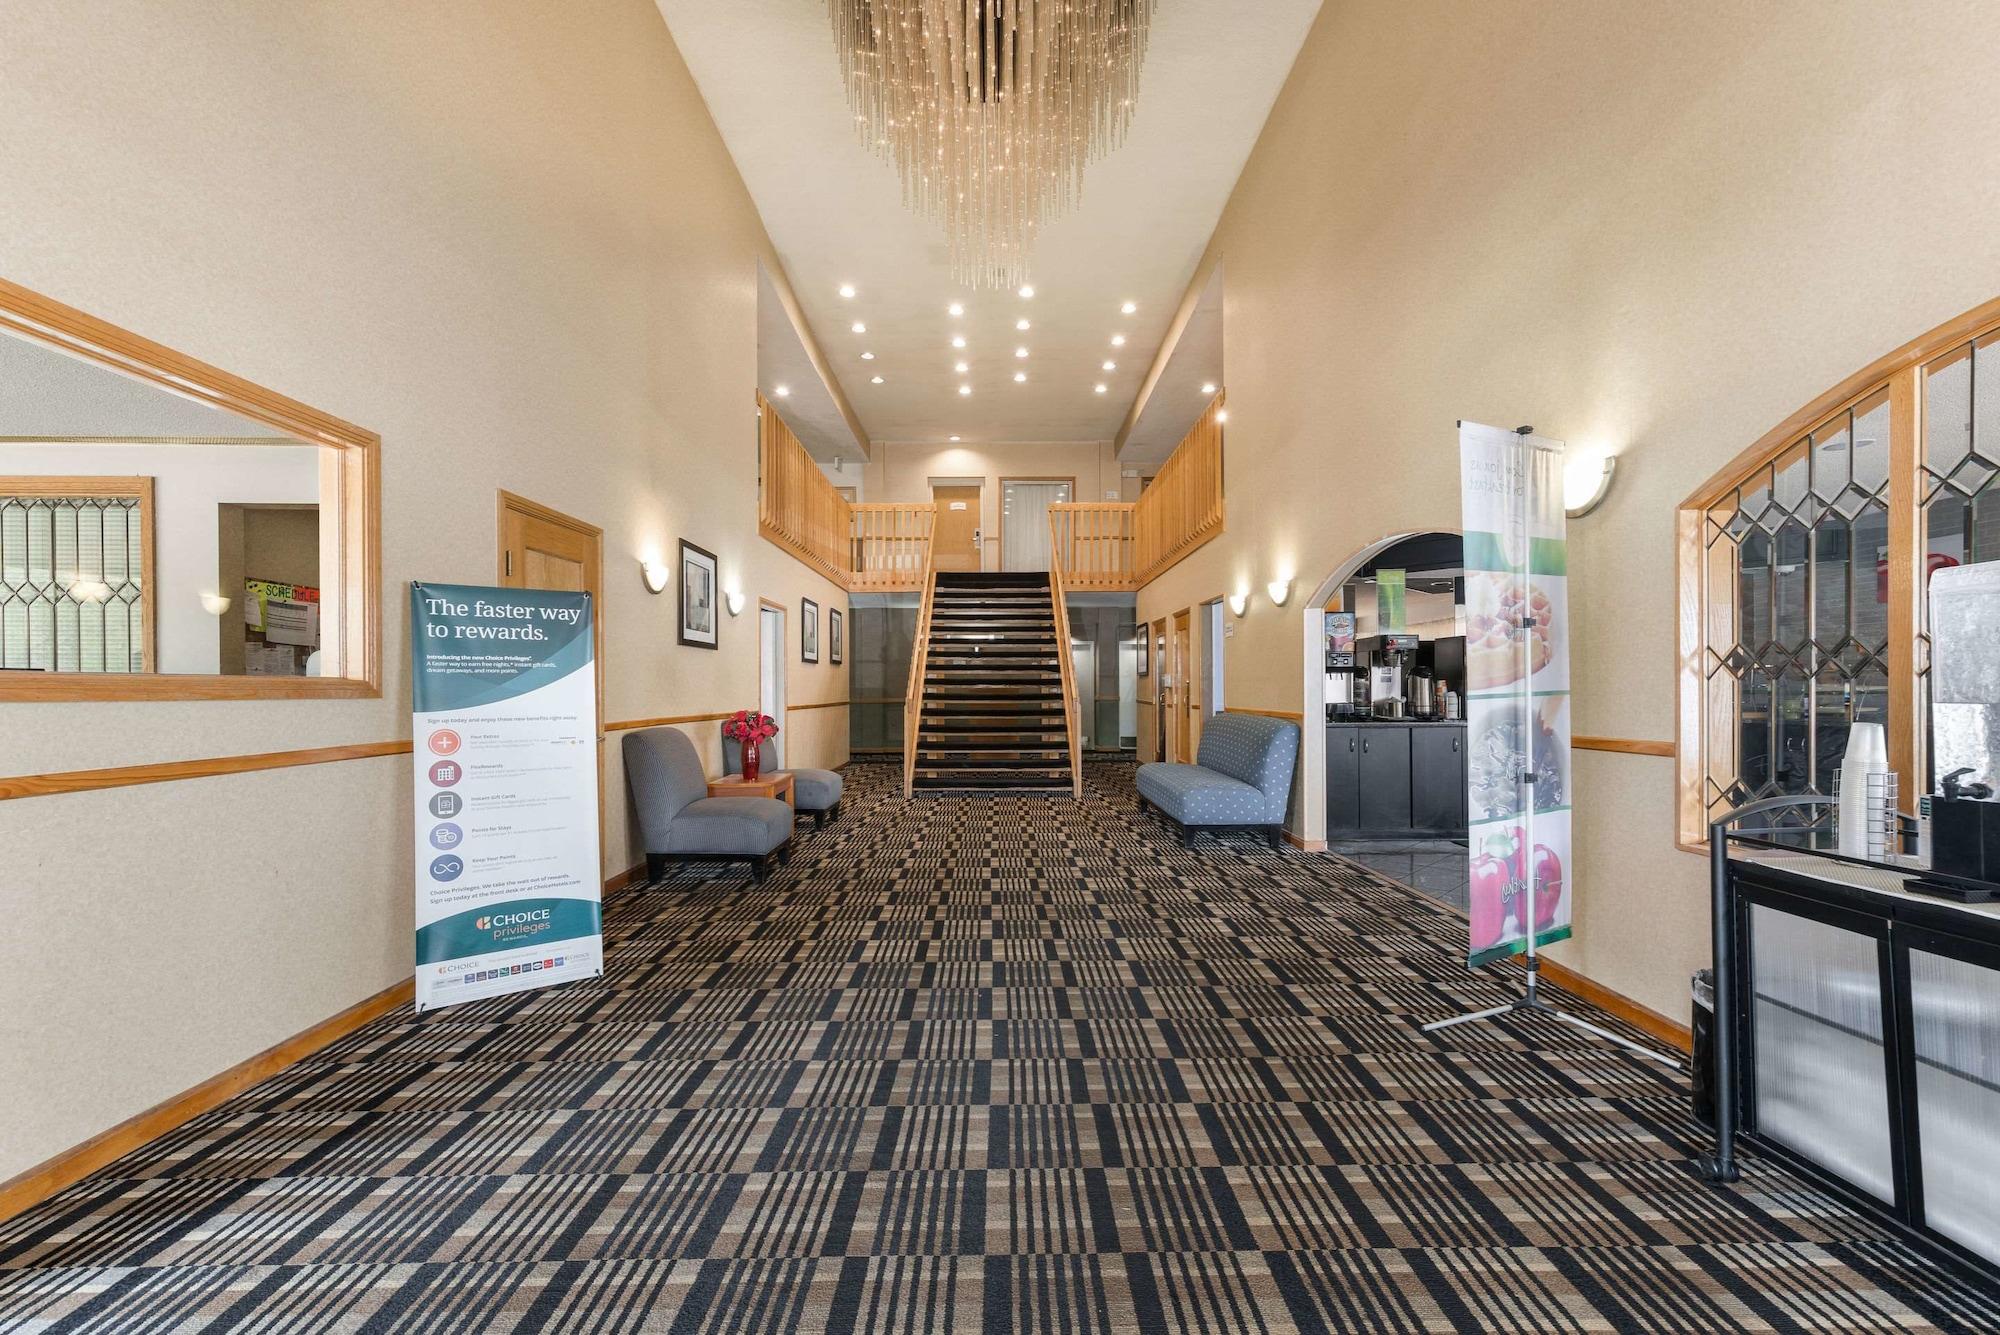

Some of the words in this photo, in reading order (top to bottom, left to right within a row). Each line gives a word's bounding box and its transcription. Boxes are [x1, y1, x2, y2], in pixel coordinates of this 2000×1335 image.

[265, 584, 317, 601] SCHEDULE
[426, 599, 468, 616] The
[474, 600, 535, 619] faster
[539, 607, 581, 625] way
[426, 622, 448, 638] to
[454, 624, 548, 641] rewards.
[430, 888, 451, 896] Choice
[451, 885, 481, 893] Privileges.
[493, 909, 551, 927] CHOICE
[493, 921, 551, 941] privileges
[447, 961, 480, 972] CHOICE
